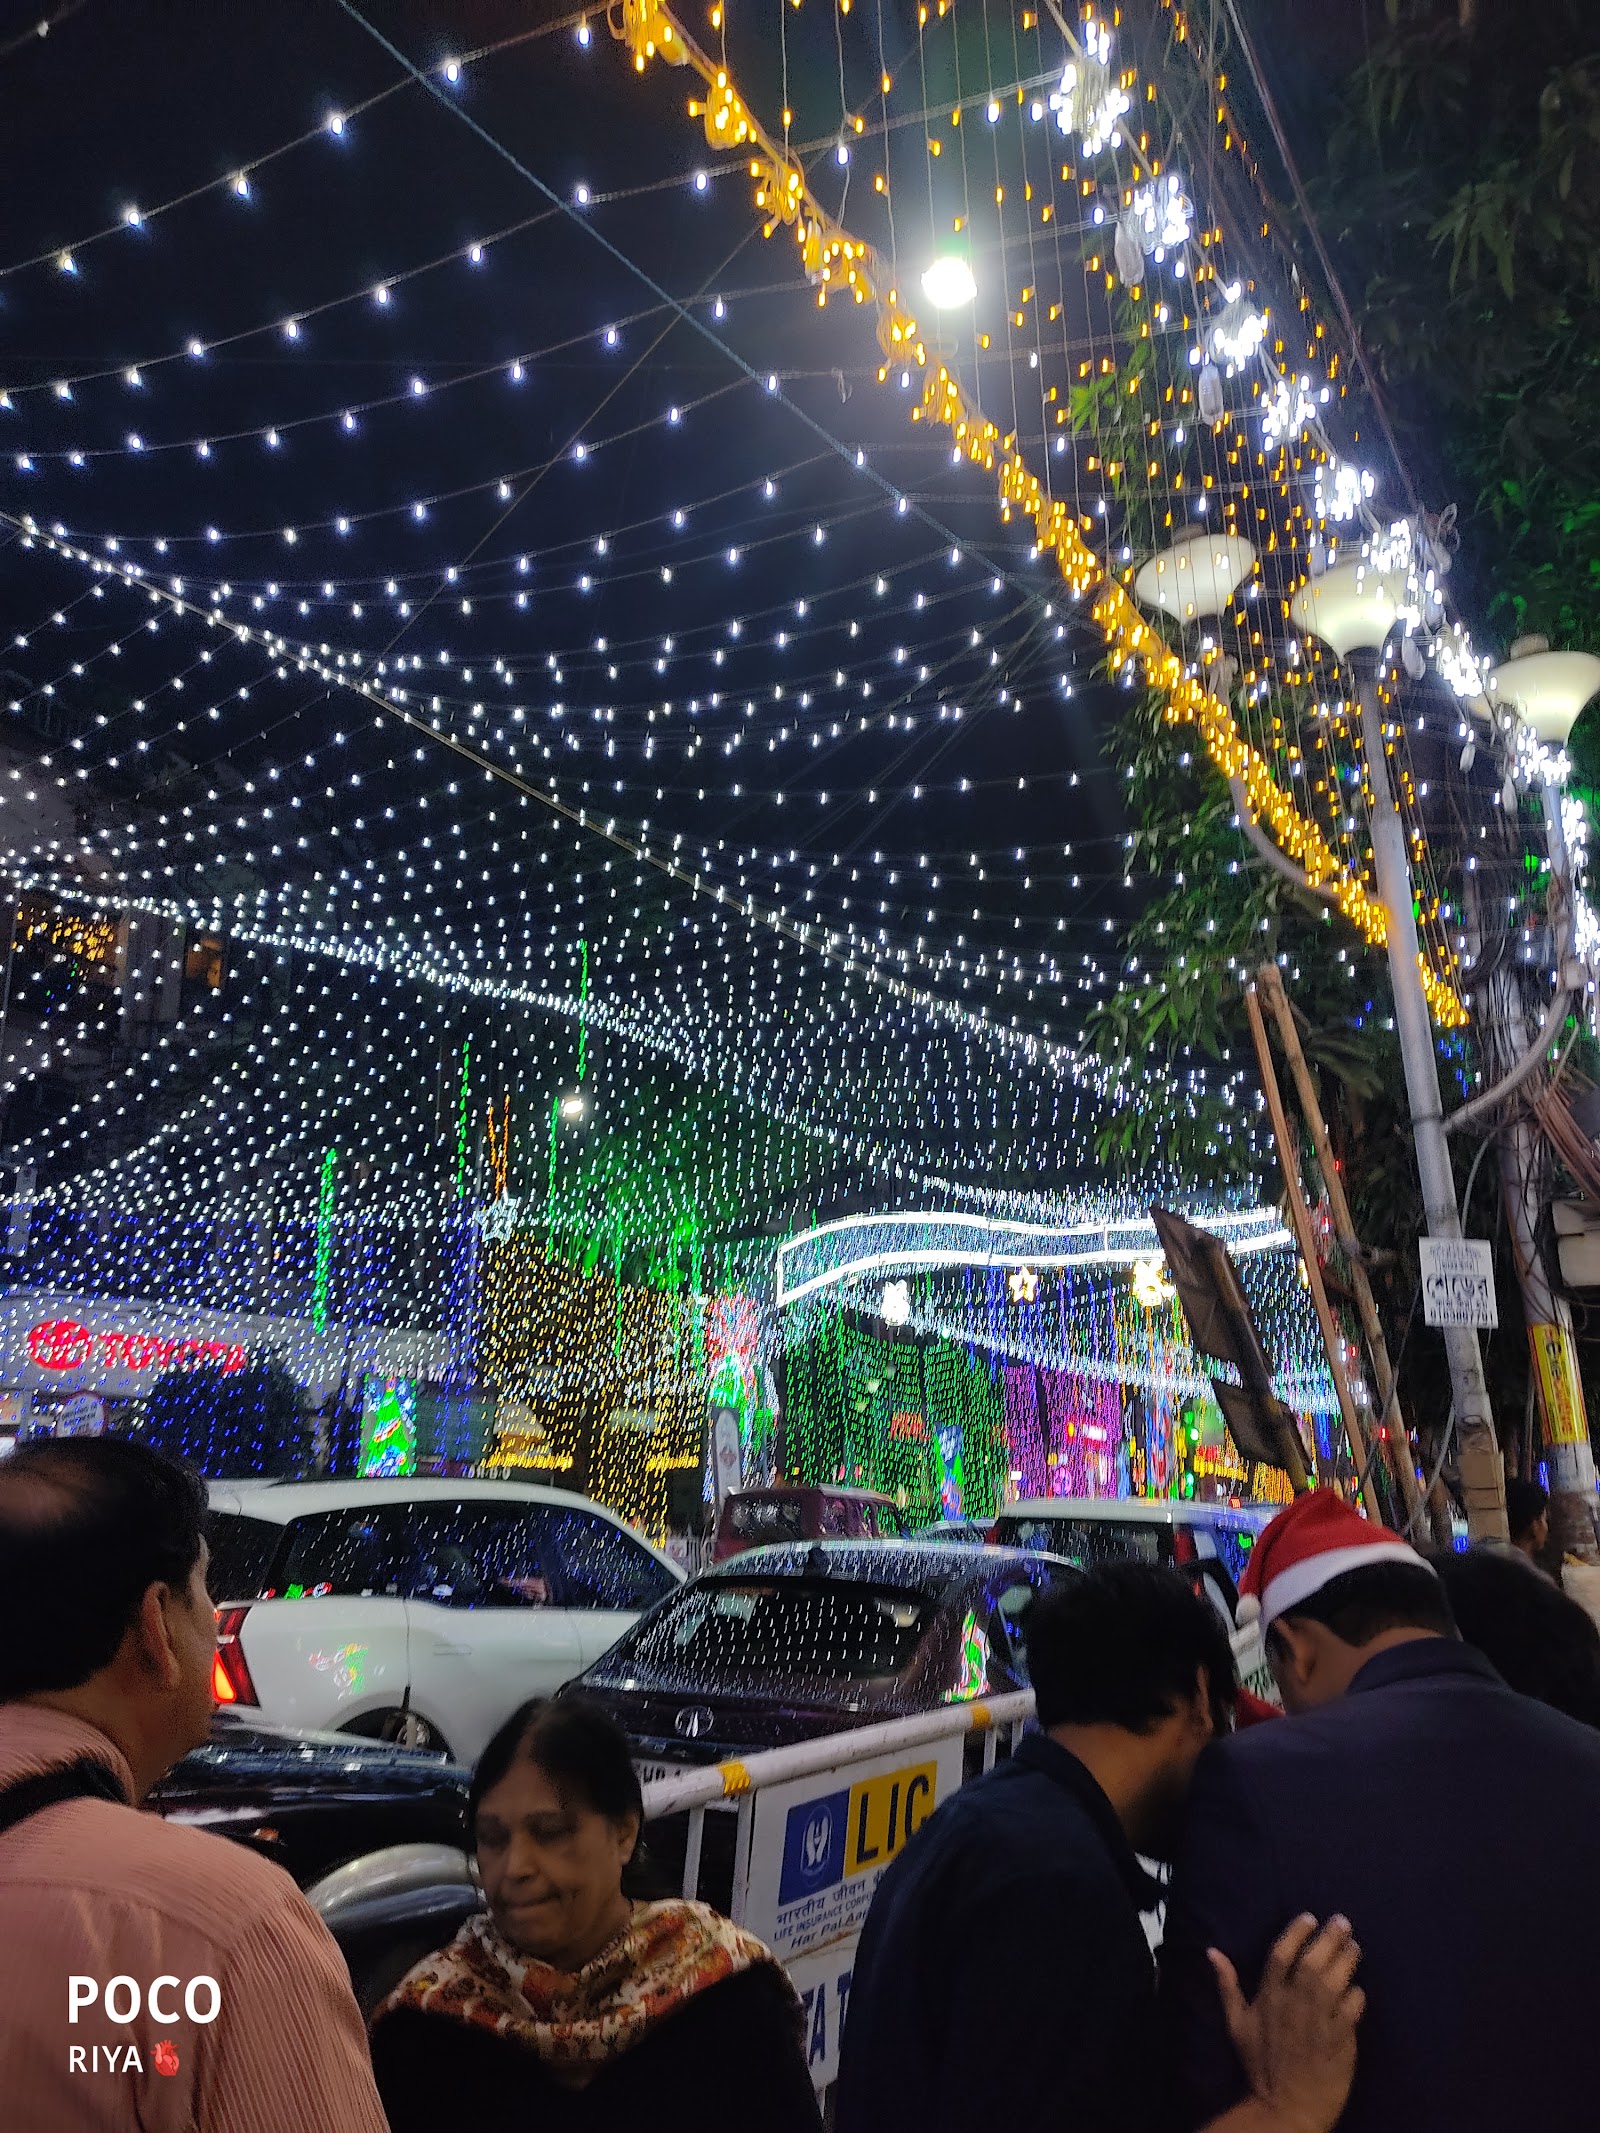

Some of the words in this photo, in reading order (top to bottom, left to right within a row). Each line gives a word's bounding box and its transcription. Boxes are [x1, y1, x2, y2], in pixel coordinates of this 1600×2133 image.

[856, 1774, 930, 1864] LIC
[774, 1925, 794, 1942] LIFE
[796, 1904, 843, 1932] INSURANCE
[777, 1896, 826, 1925] भारतीय
[833, 1879, 866, 1902] जीवन
[791, 1930, 818, 1949] Har
[821, 1916, 842, 1936] Pal
